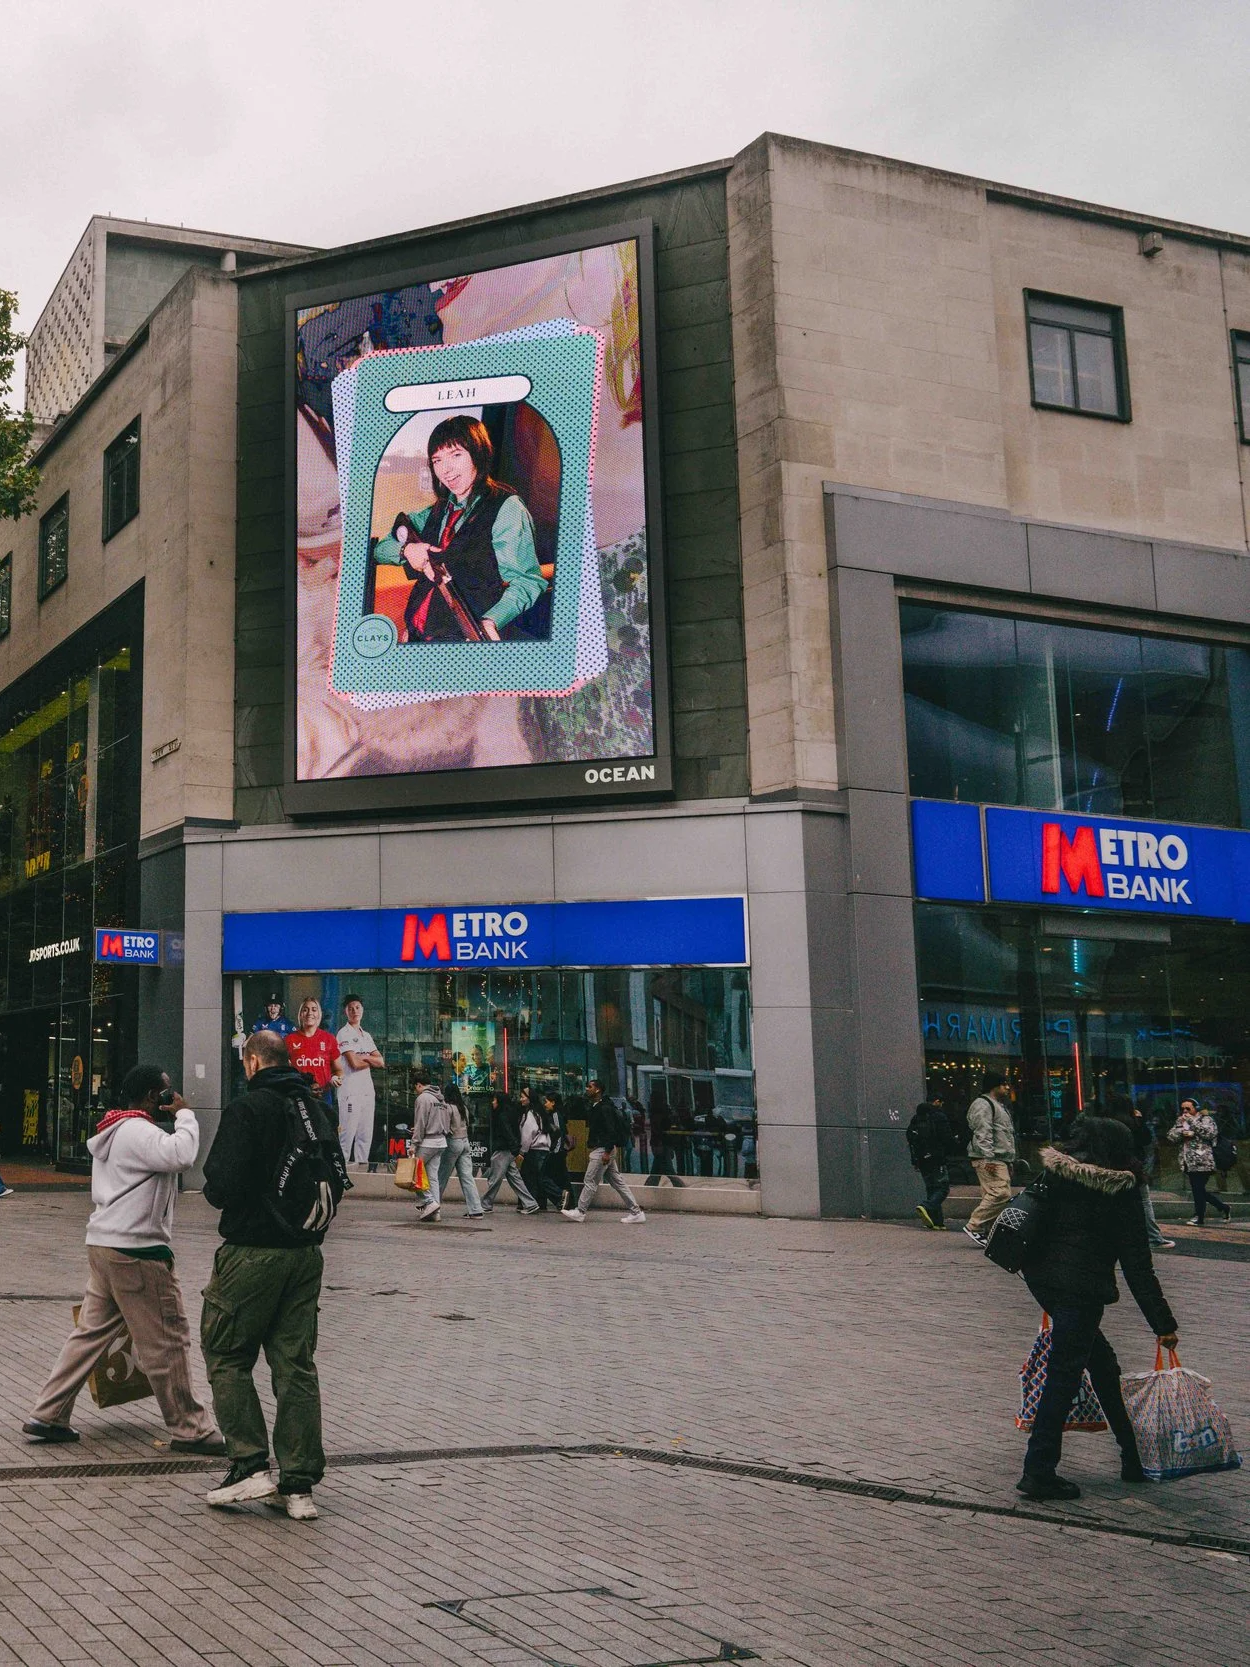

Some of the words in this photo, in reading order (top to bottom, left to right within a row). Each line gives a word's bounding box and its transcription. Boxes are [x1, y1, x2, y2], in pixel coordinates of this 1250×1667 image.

[438, 388, 475, 400] LEAH
[584, 765, 655, 784] OCEAN
[1042, 823, 1188, 896] METRO
[1107, 873, 1192, 904] BANK
[101, 934, 155, 957] METRO
[401, 911, 528, 961] METRO
[28, 937, 81, 963] JDSPORTS.CO.UK
[124, 949, 155, 959] BANK
[456, 941, 528, 960] BANK
[296, 1056, 325, 1067] cinch
